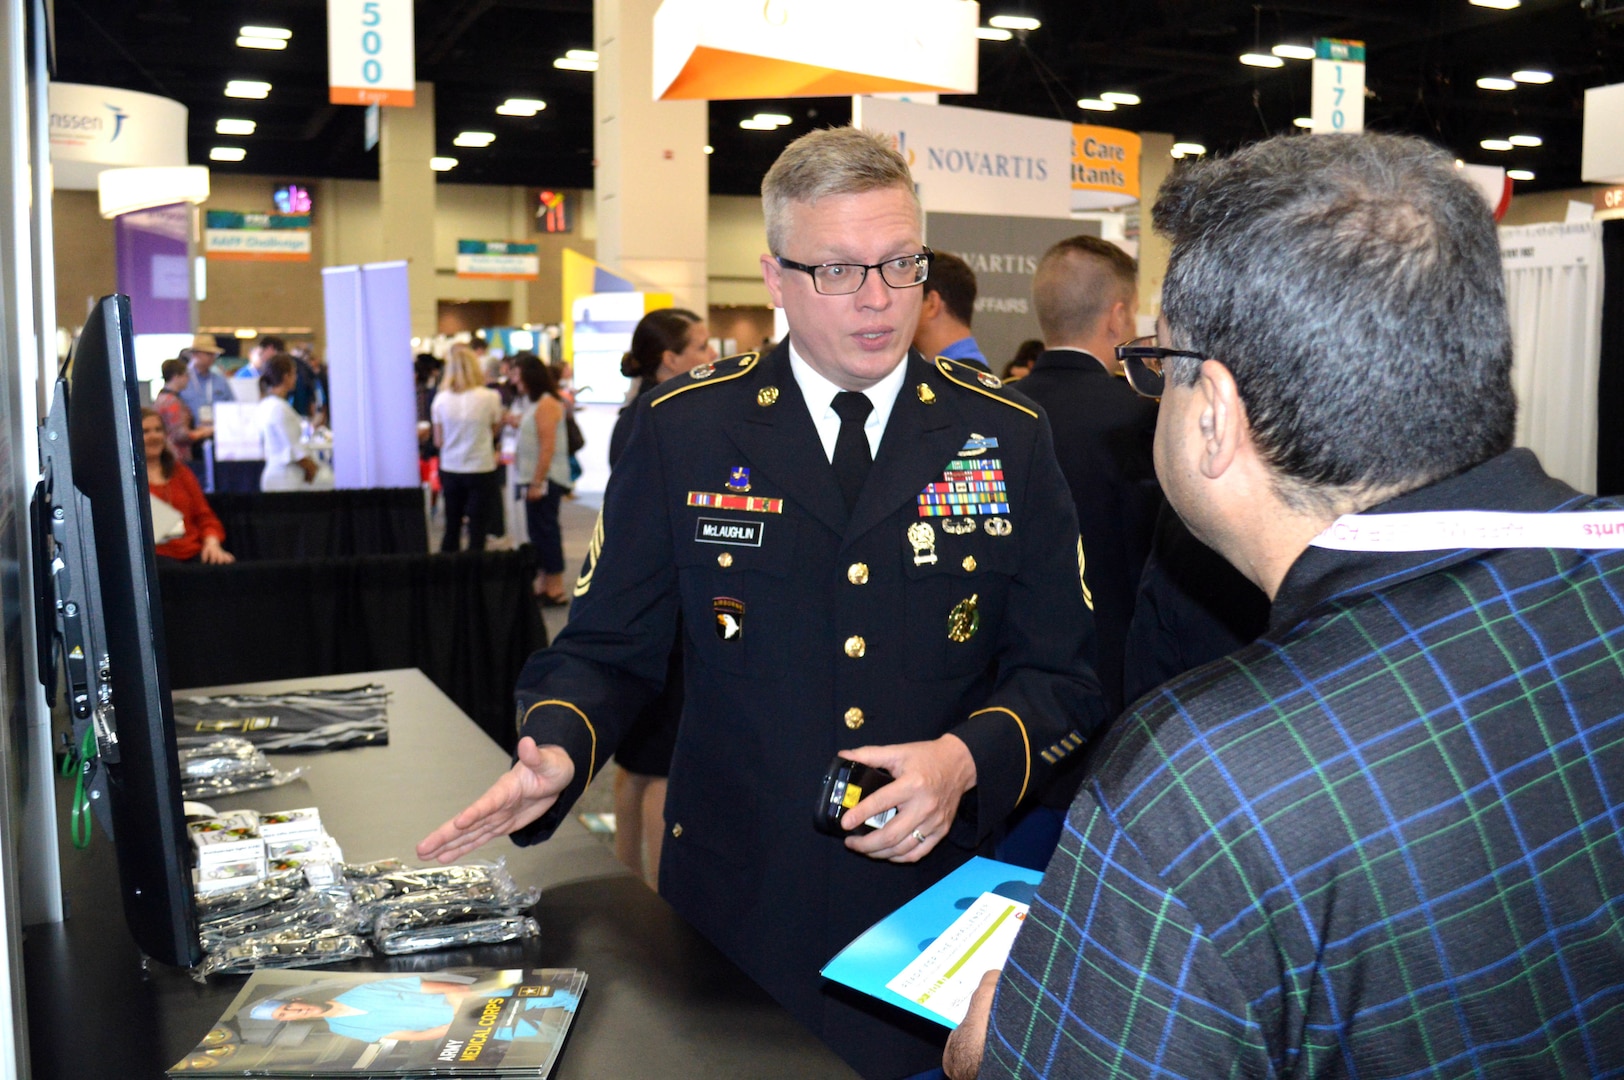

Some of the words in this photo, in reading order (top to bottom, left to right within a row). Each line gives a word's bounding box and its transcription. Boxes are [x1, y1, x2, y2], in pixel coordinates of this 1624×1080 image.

[1331, 64, 1345, 133] 170
[1084, 138, 1124, 161] Care
[928, 147, 1048, 181] NOVARTIS
[959, 252, 1038, 274] VARTIS
[702, 524, 754, 540] McLAUGHLIN
[458, 1027, 493, 1061] MEDICAL
[478, 998, 505, 1026] CORPS
[437, 1040, 464, 1061] ARMY
